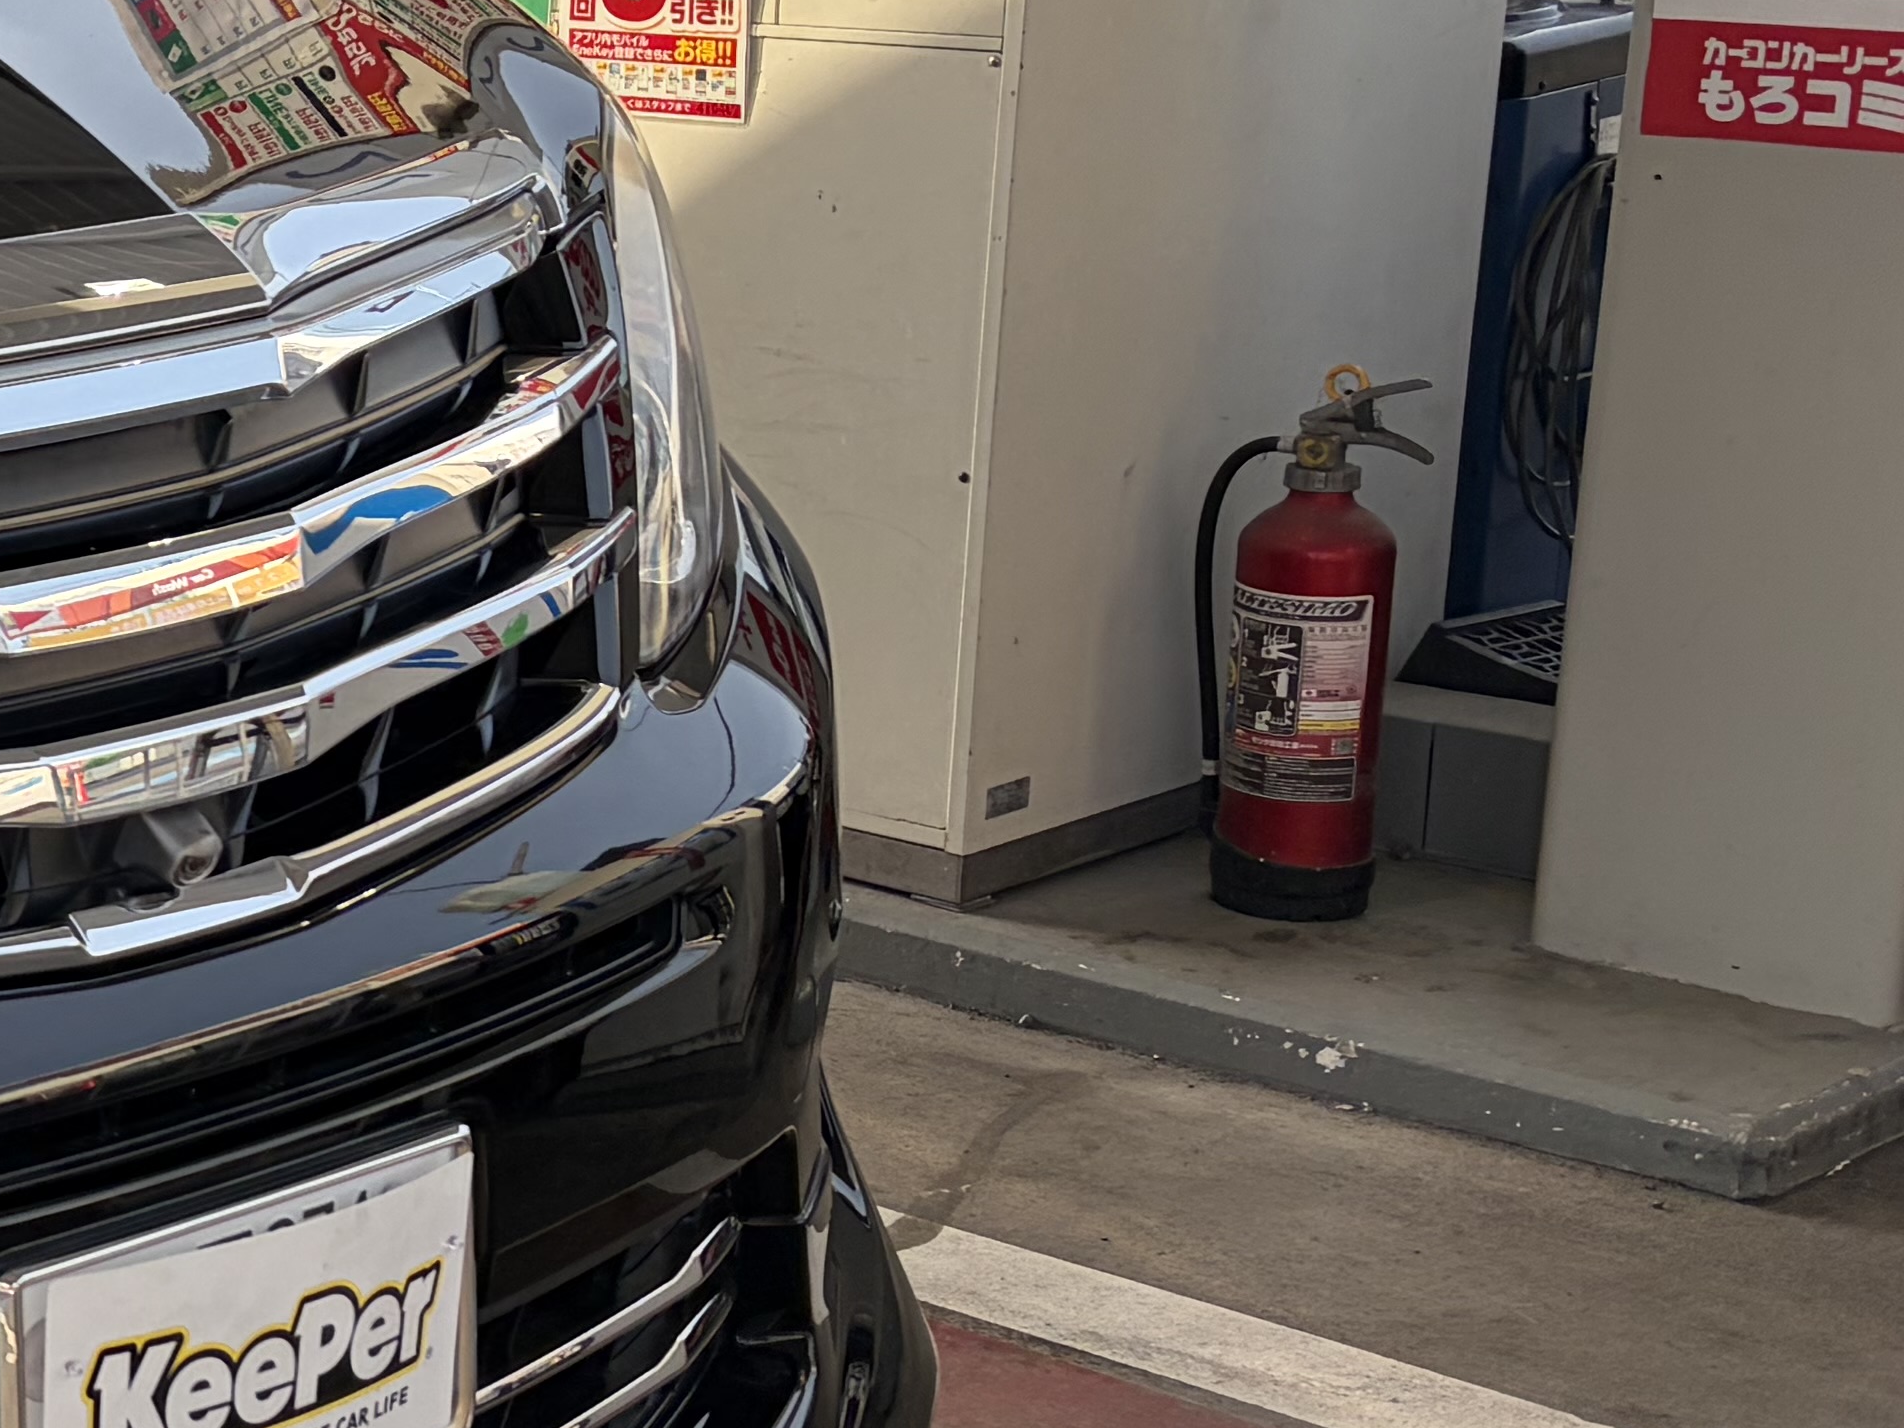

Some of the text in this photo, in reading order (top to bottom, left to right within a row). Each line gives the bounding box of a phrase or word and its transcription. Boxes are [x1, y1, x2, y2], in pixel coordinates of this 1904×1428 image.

[573, 31, 649, 47] アプリ内モバイル
[374, 1385, 410, 1421] LIFE
